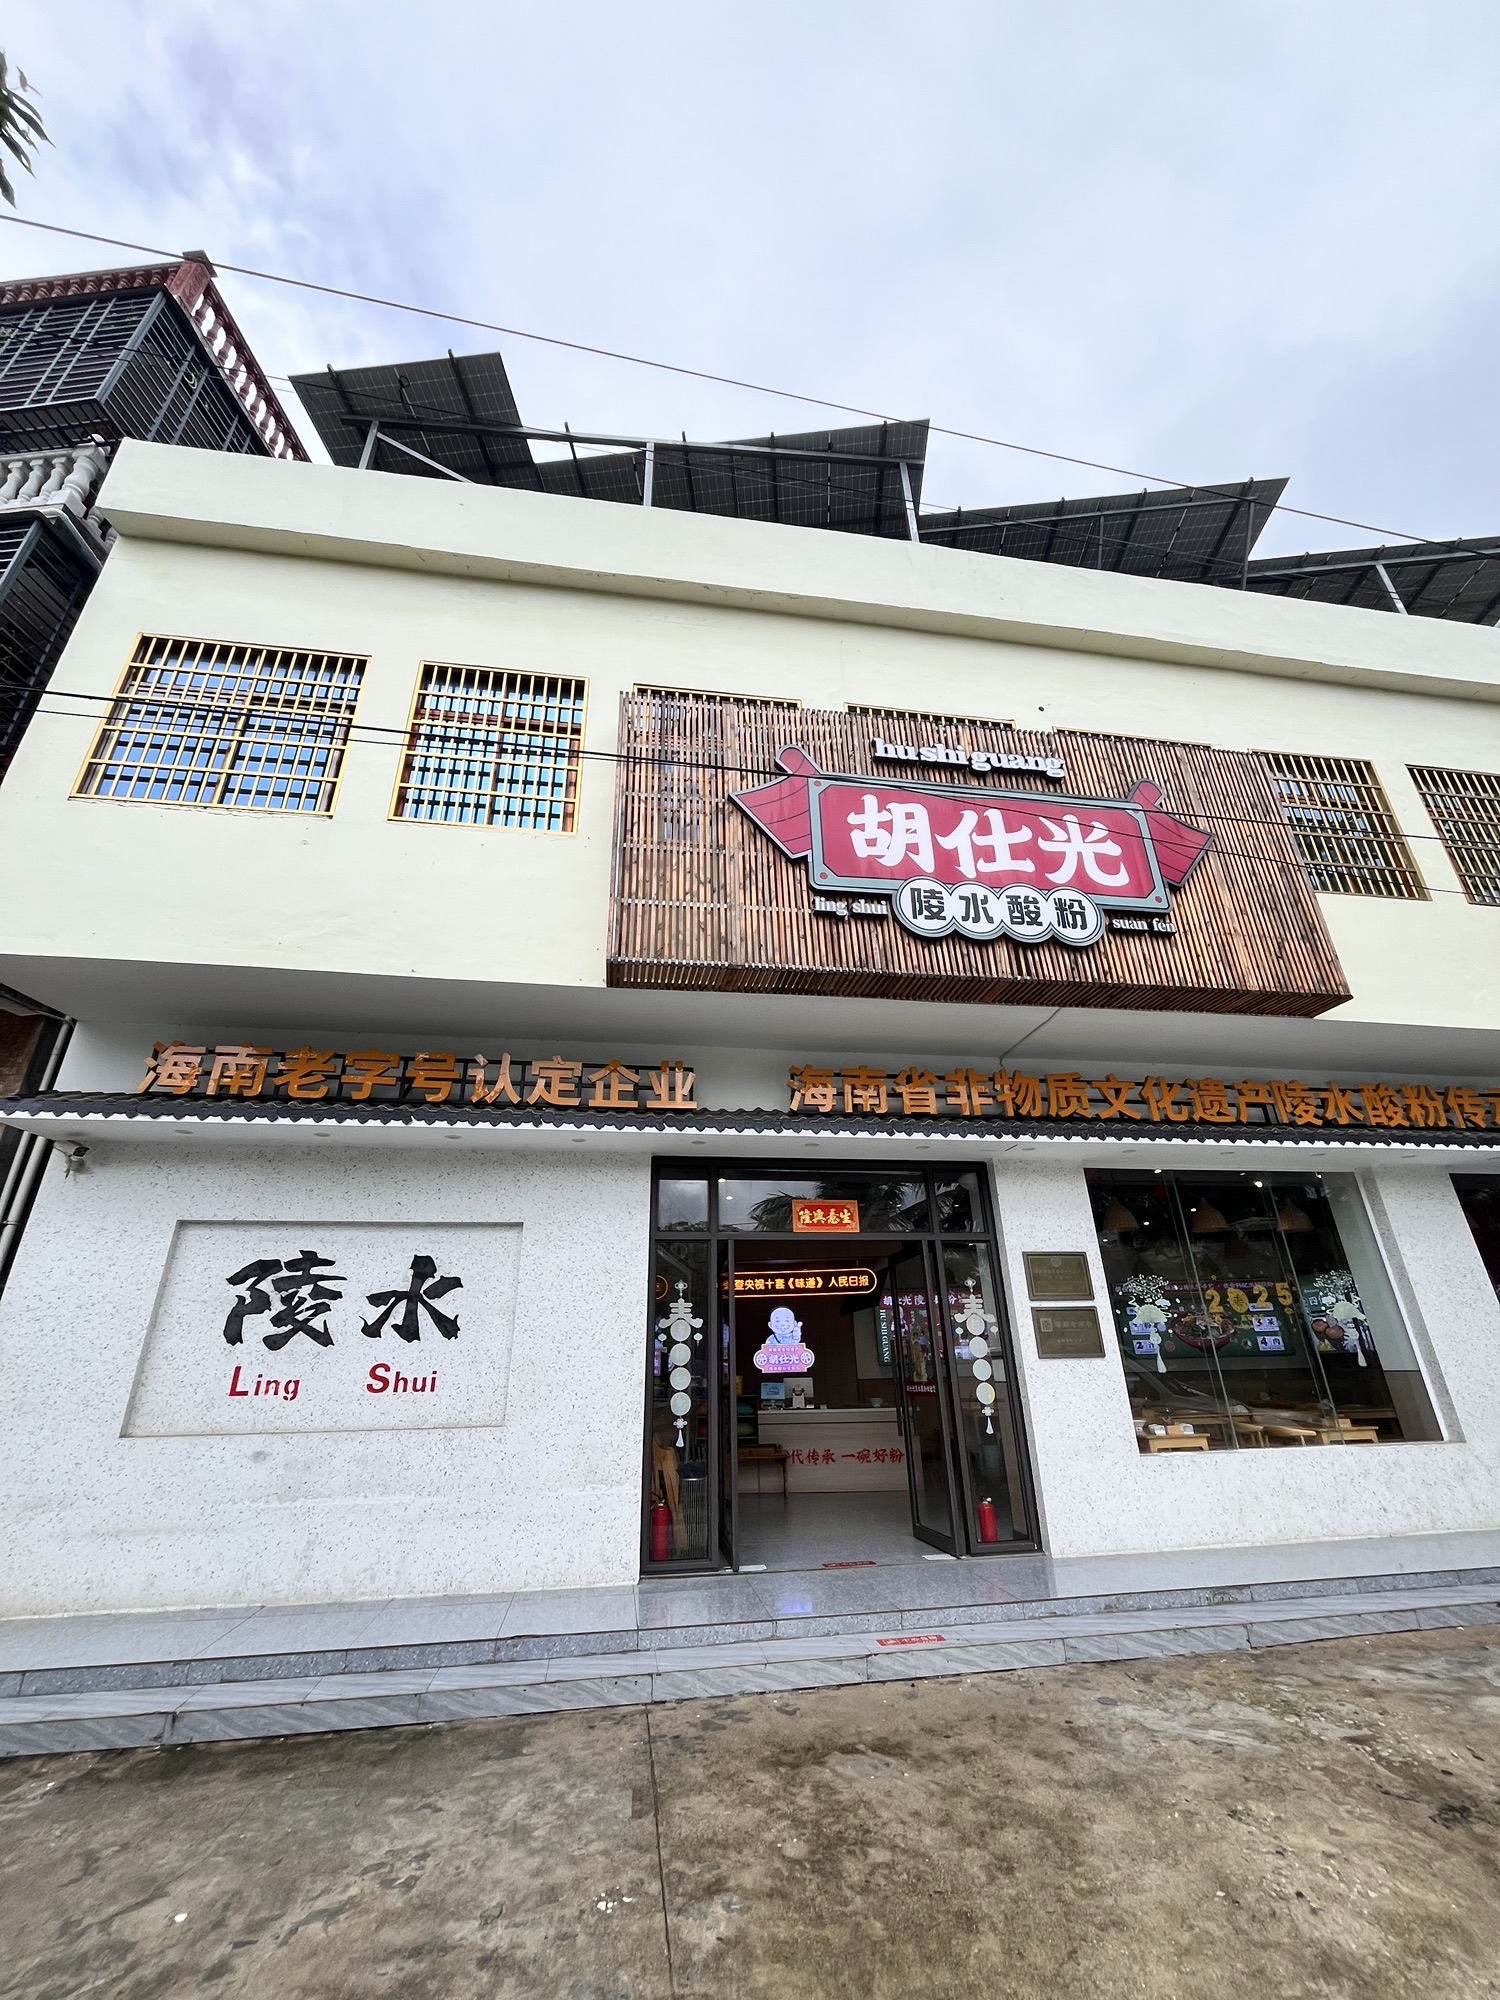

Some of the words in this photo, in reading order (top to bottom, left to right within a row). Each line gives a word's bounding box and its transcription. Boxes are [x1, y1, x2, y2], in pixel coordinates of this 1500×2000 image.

[846, 793, 1130, 887] 胡仕光
[814, 896, 848, 916] ling
[852, 899, 889, 915] shui
[909, 887, 1089, 931] 陵水酸粉
[1152, 918, 1177, 933] fen
[136, 1041, 698, 1110] 海南老字号认定企业
[223, 1250, 464, 1351] 陵水
[768, 1353, 800, 1365] 胡仕光
[228, 1366, 301, 1401] Ling
[366, 1362, 438, 1395] Shui
